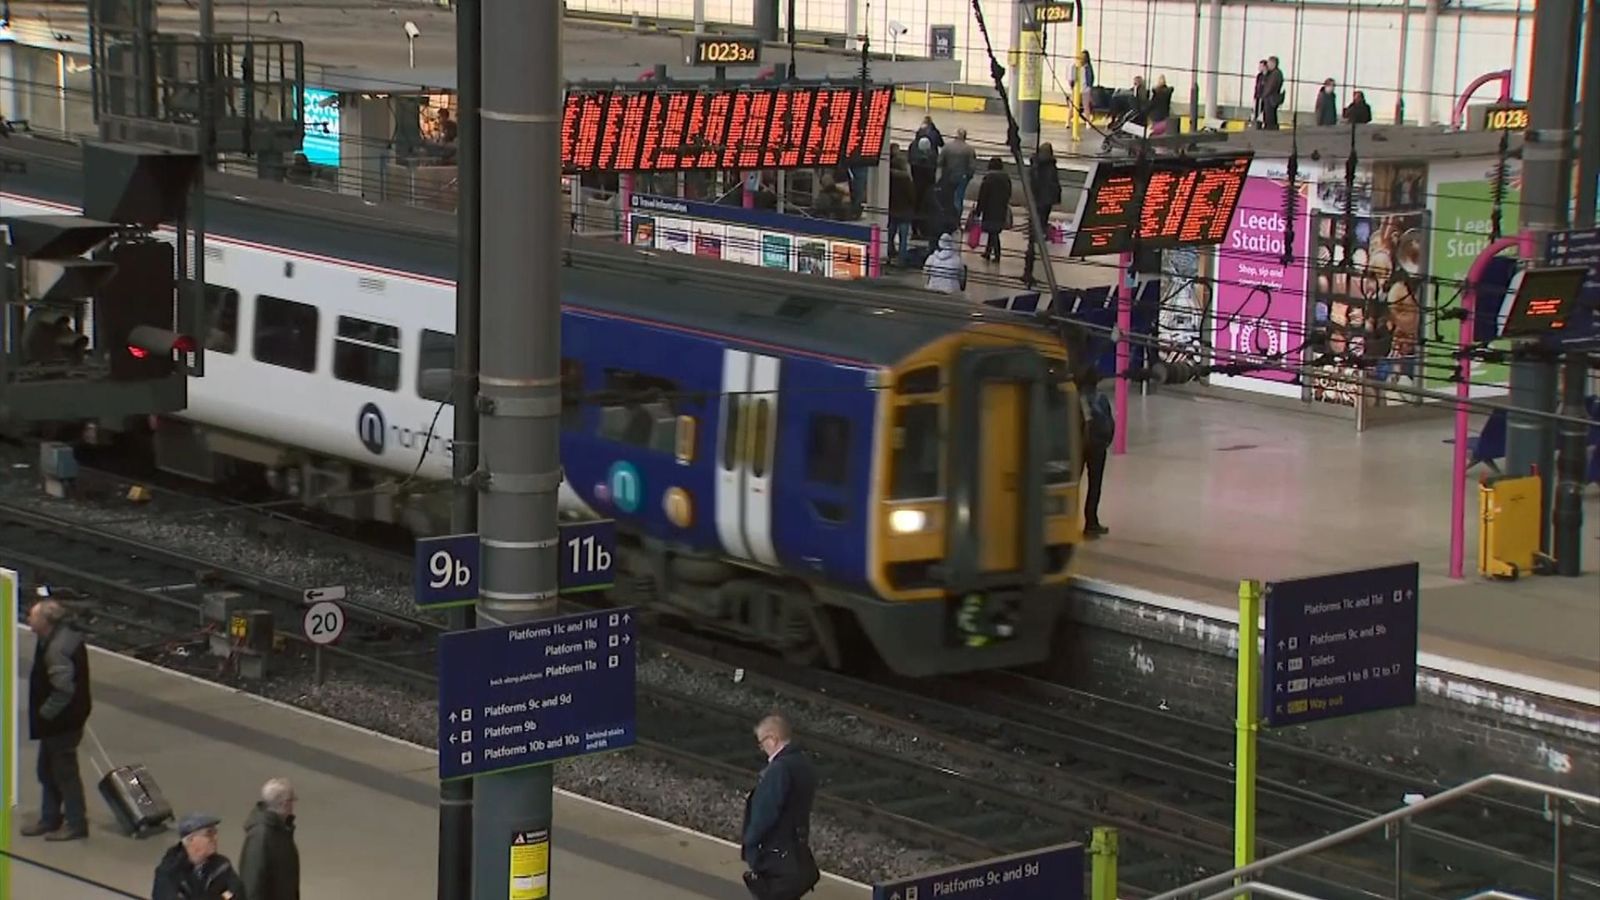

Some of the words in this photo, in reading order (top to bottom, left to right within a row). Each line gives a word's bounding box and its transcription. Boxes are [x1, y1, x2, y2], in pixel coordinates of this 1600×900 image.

[1240, 209, 1286, 232] Leeds
[1269, 268, 1284, 278] and
[568, 535, 611, 573] 11b
[429, 551, 471, 588] 9b
[1304, 602, 1341, 615] Platforms
[1355, 595, 1370, 607] and
[312, 612, 337, 635] 20
[509, 627, 551, 641] Platforms
[553, 624, 565, 634] 11c
[567, 621, 583, 632] and
[585, 618, 597, 630] 11d
[1309, 632, 1347, 646] Platforms
[1348, 629, 1358, 640] 9c
[1360, 626, 1374, 638] and
[545, 643, 582, 656] Platform
[584, 640, 597, 650] 11b
[545, 664, 583, 677] Platform
[585, 660, 597, 671] 11a
[1310, 655, 1335, 667] Toilets
[1309, 675, 1346, 689] Platforms
[1353, 671, 1361, 681] to
[1362, 669, 1369, 679] 8
[1372, 667, 1381, 678] 12
[1382, 666, 1391, 676] to
[1391, 664, 1401, 674] 17
[484, 703, 527, 718] Platforms
[528, 699, 540, 710] 9c
[542, 696, 558, 708] and
[559, 693, 572, 705] 9d
[1309, 698, 1327, 710] Way
[1328, 696, 1344, 707] out
[484, 724, 522, 739] Platform
[524, 720, 537, 731] 9b
[484, 745, 527, 760] Platforms
[529, 740, 544, 751] 10b
[546, 738, 562, 749] and
[564, 734, 580, 746] 10a
[933, 876, 985, 897] Platforms
[987, 871, 1000, 884] 9c
[1003, 865, 1023, 882] and
[1024, 862, 1039, 877] 9d
